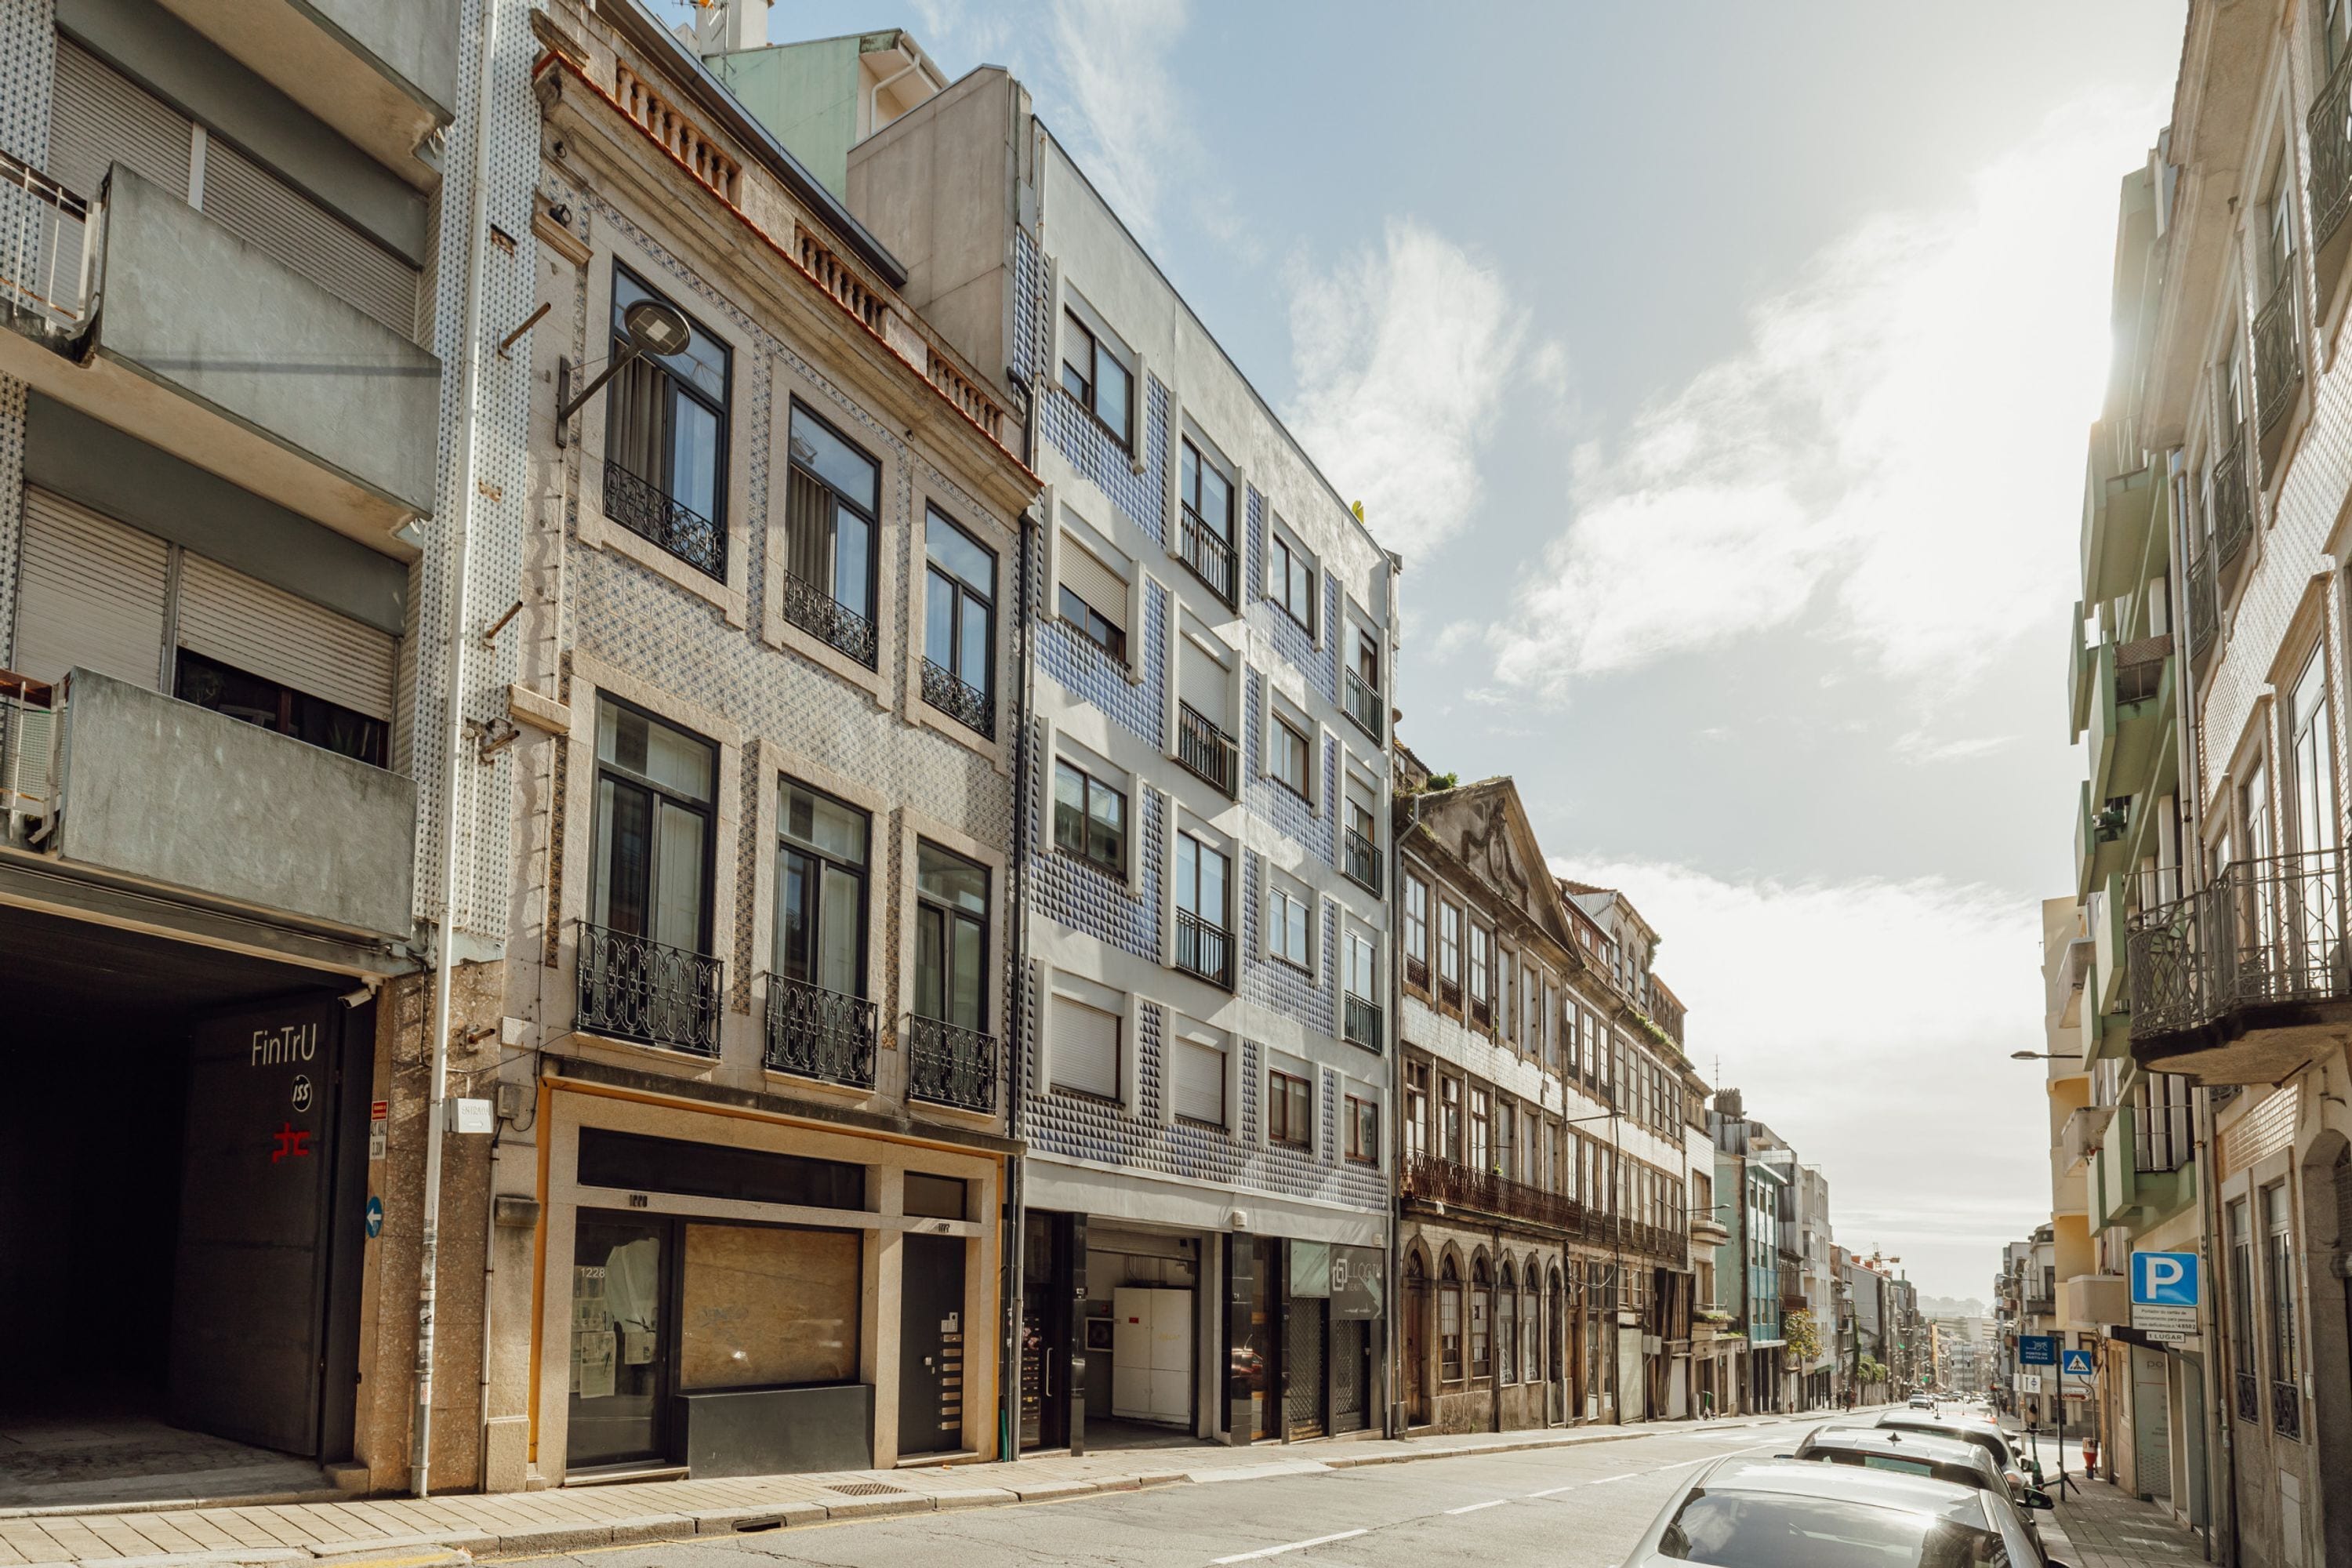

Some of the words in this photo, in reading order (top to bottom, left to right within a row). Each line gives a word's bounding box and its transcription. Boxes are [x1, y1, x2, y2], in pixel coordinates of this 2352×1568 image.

[252, 1022, 317, 1066] FinTrU
[581, 1267, 605, 1278] 1228
[2146, 1257, 2183, 1299] P
